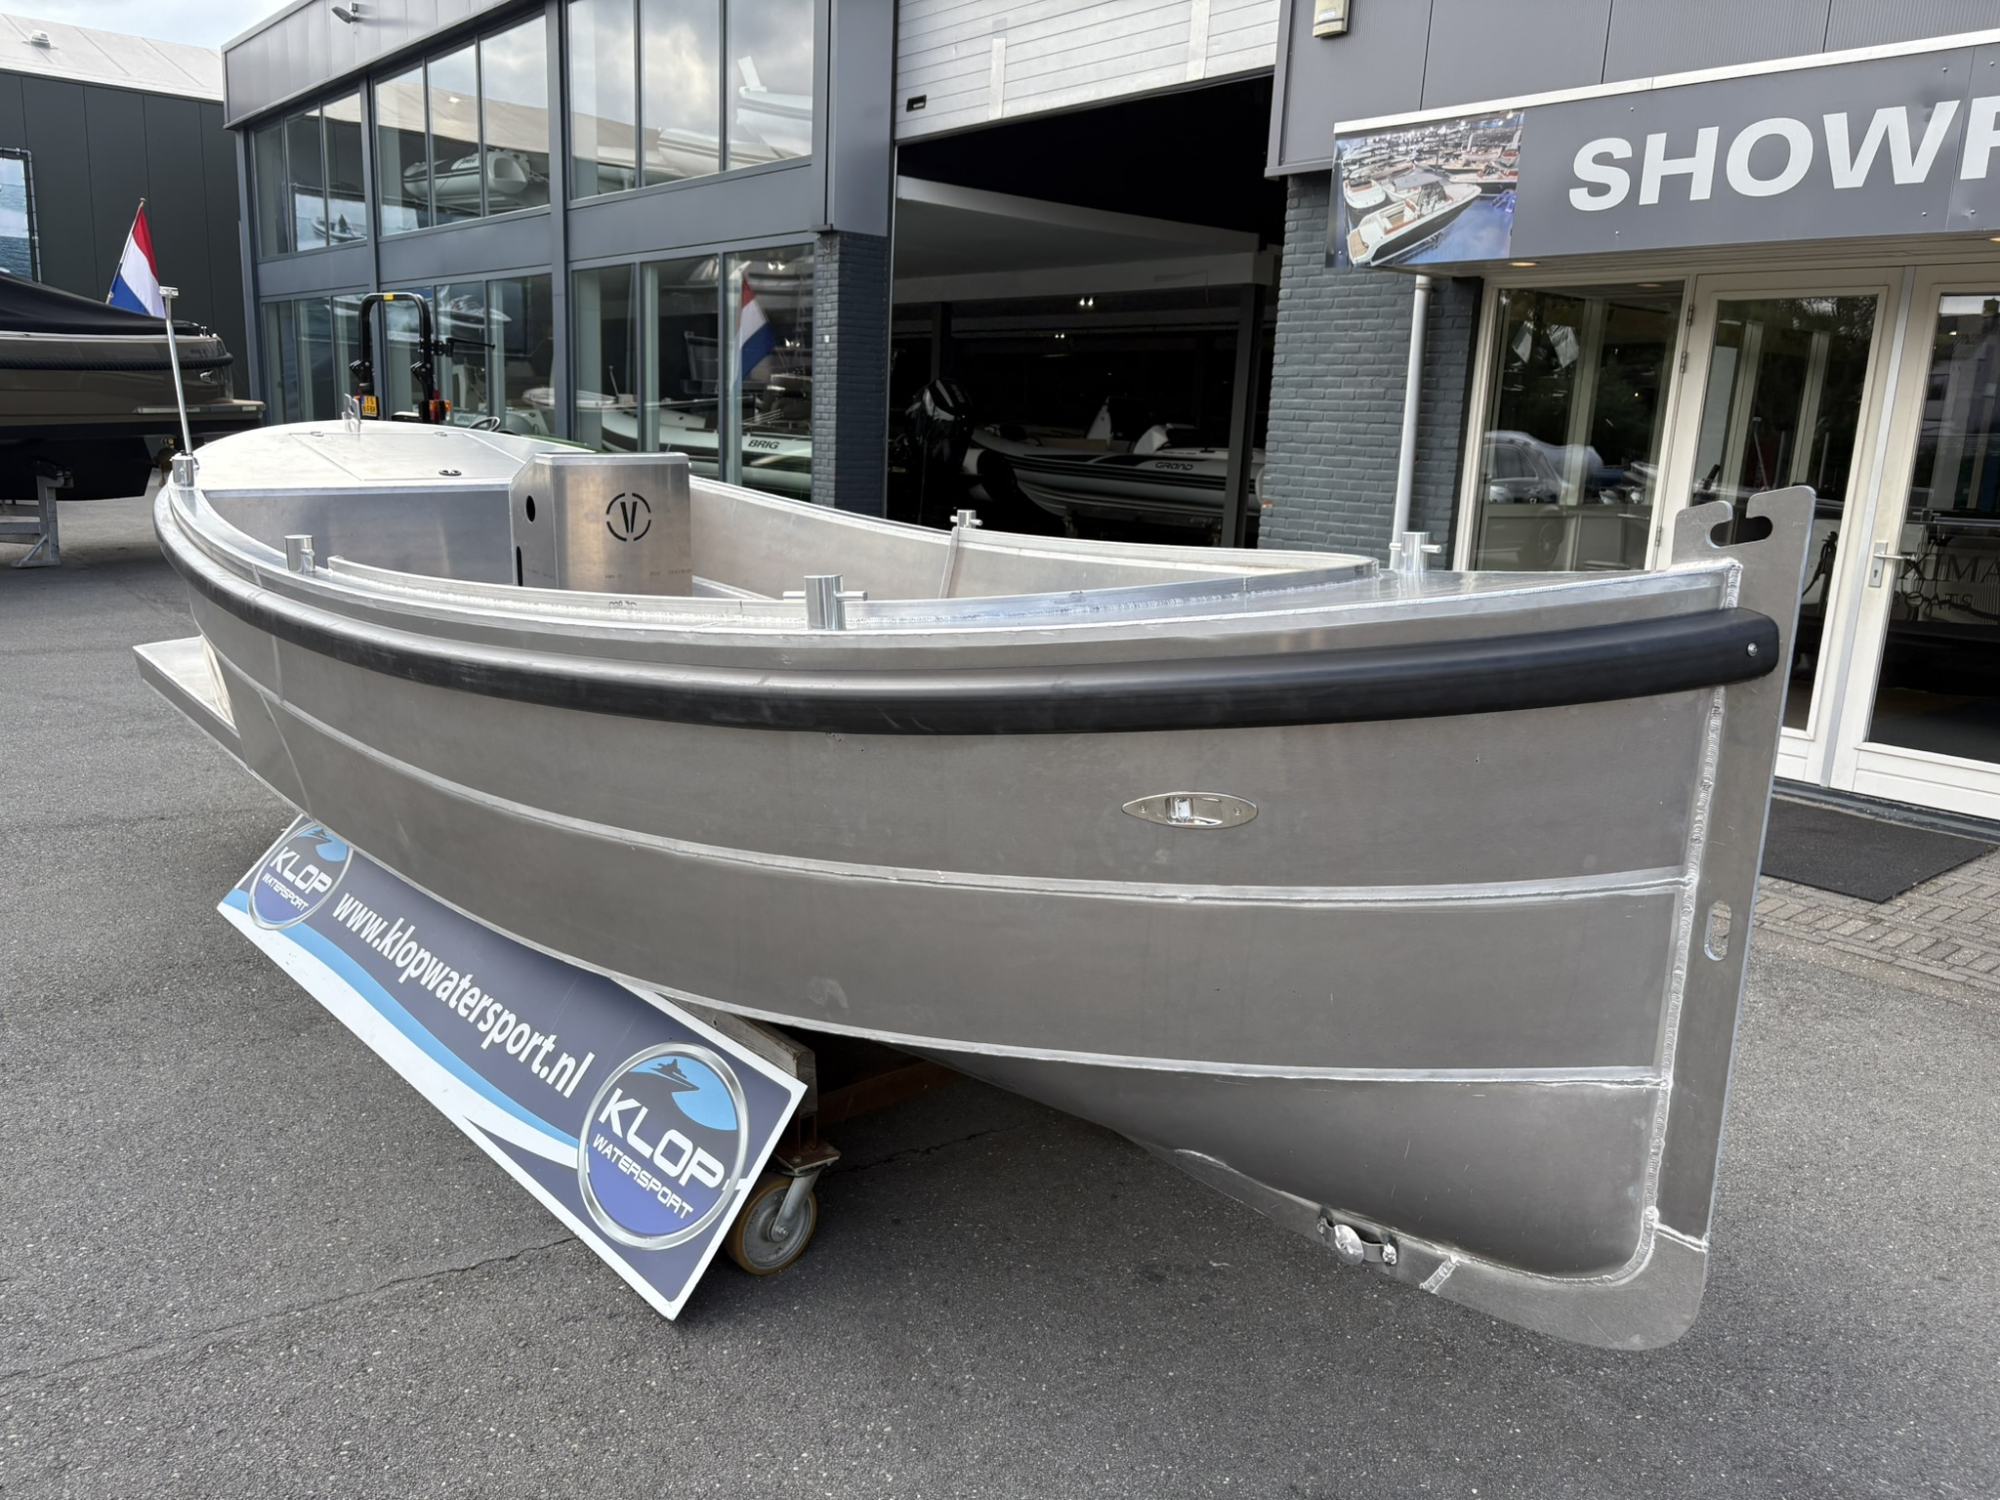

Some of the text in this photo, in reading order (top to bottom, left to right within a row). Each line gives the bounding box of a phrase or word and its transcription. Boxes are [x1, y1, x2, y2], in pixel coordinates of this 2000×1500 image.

[748, 440, 780, 449] BRIG
[262, 873, 309, 911] WATERSPORT
[269, 846, 333, 895] KLOP
[332, 891, 595, 1099] www.klopwatersport.nl
[598, 1086, 725, 1192] KLOP
[593, 1133, 694, 1221] WATERSPORT
